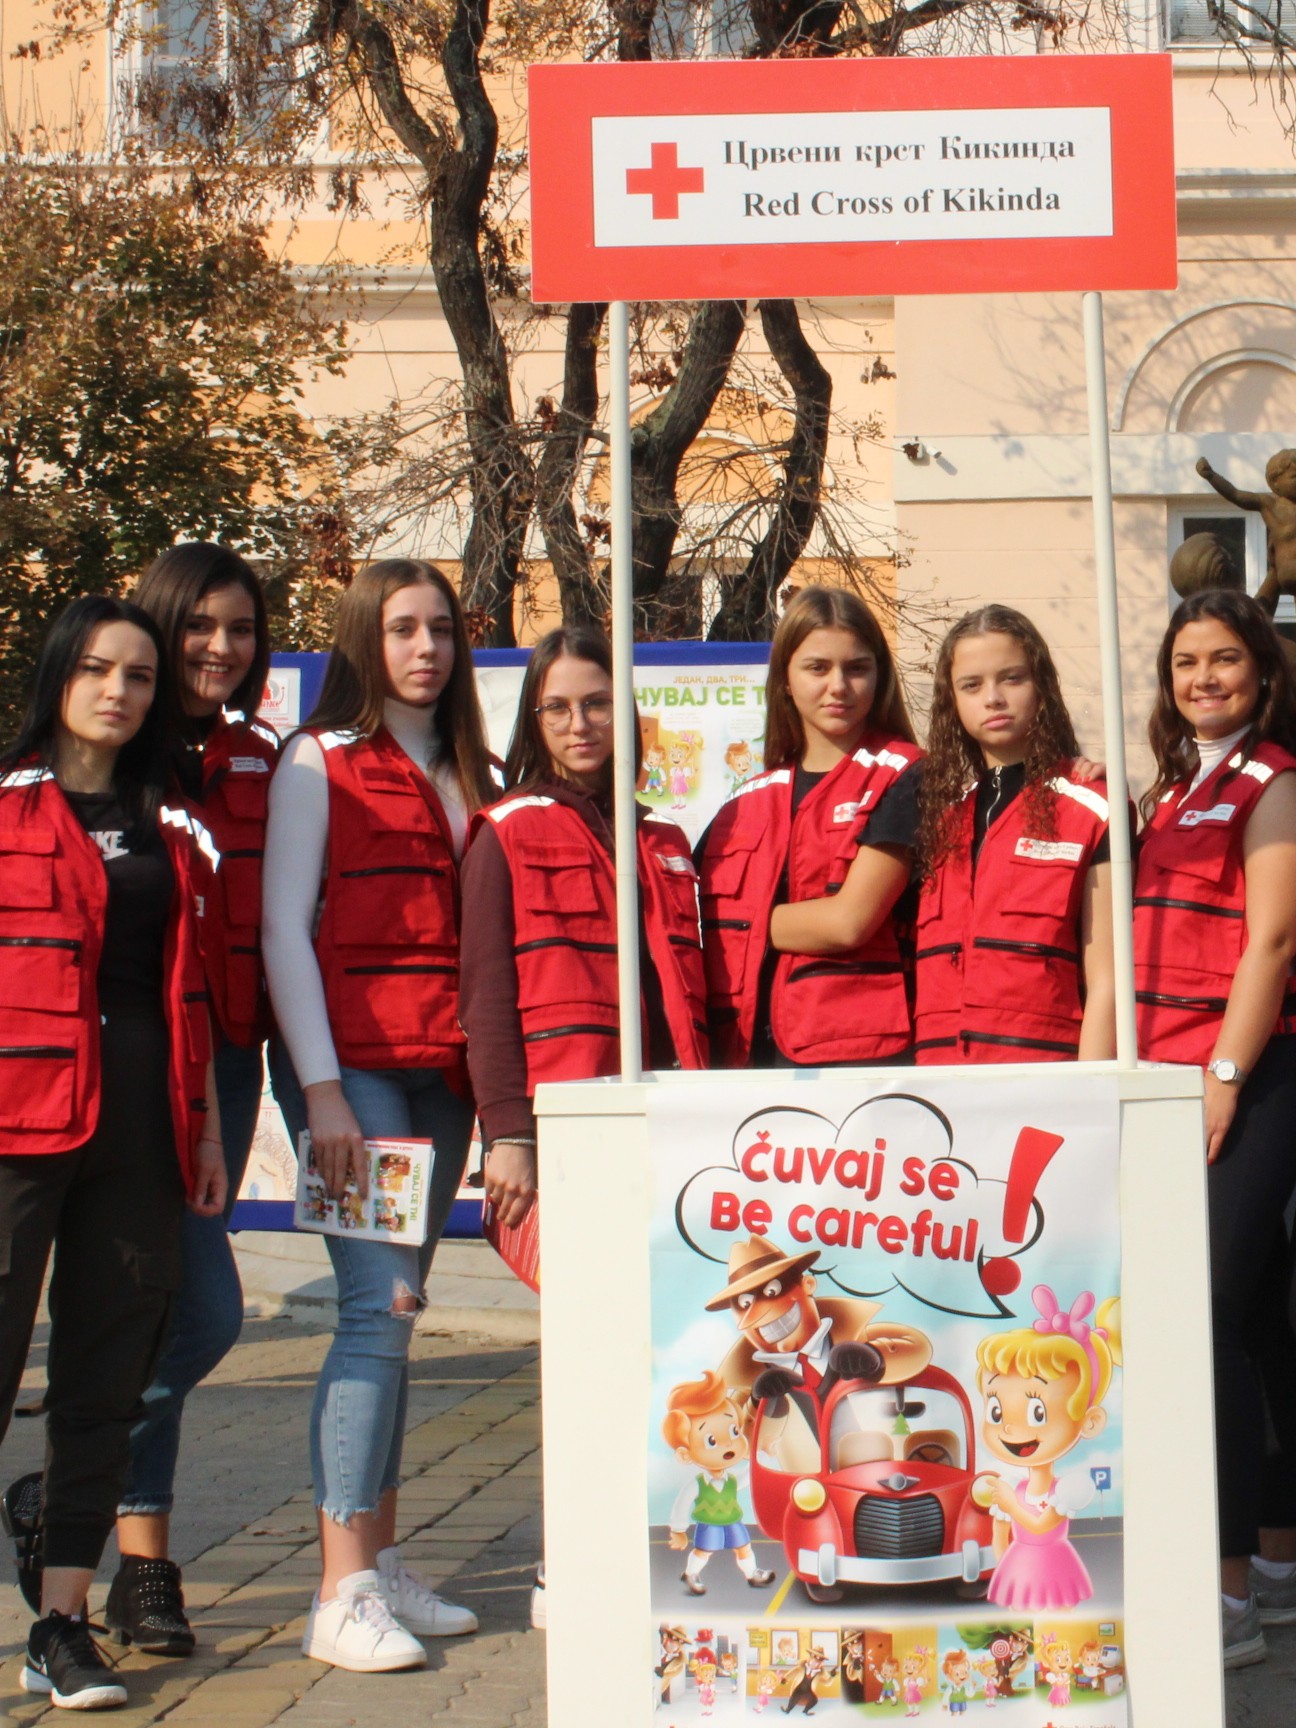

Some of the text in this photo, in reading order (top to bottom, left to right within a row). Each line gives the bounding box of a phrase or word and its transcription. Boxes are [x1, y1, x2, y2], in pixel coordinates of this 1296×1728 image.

[723, 134, 1076, 171] Црвени крст Кикинда
[743, 186, 1061, 217] Red Cross of Kikinda
[716, 686, 746, 706] СЕ
[88, 831, 124, 852] KE
[740, 1130, 960, 1201] Čuvaj se
[710, 1191, 772, 1236] Be
[788, 1203, 979, 1262] careful
